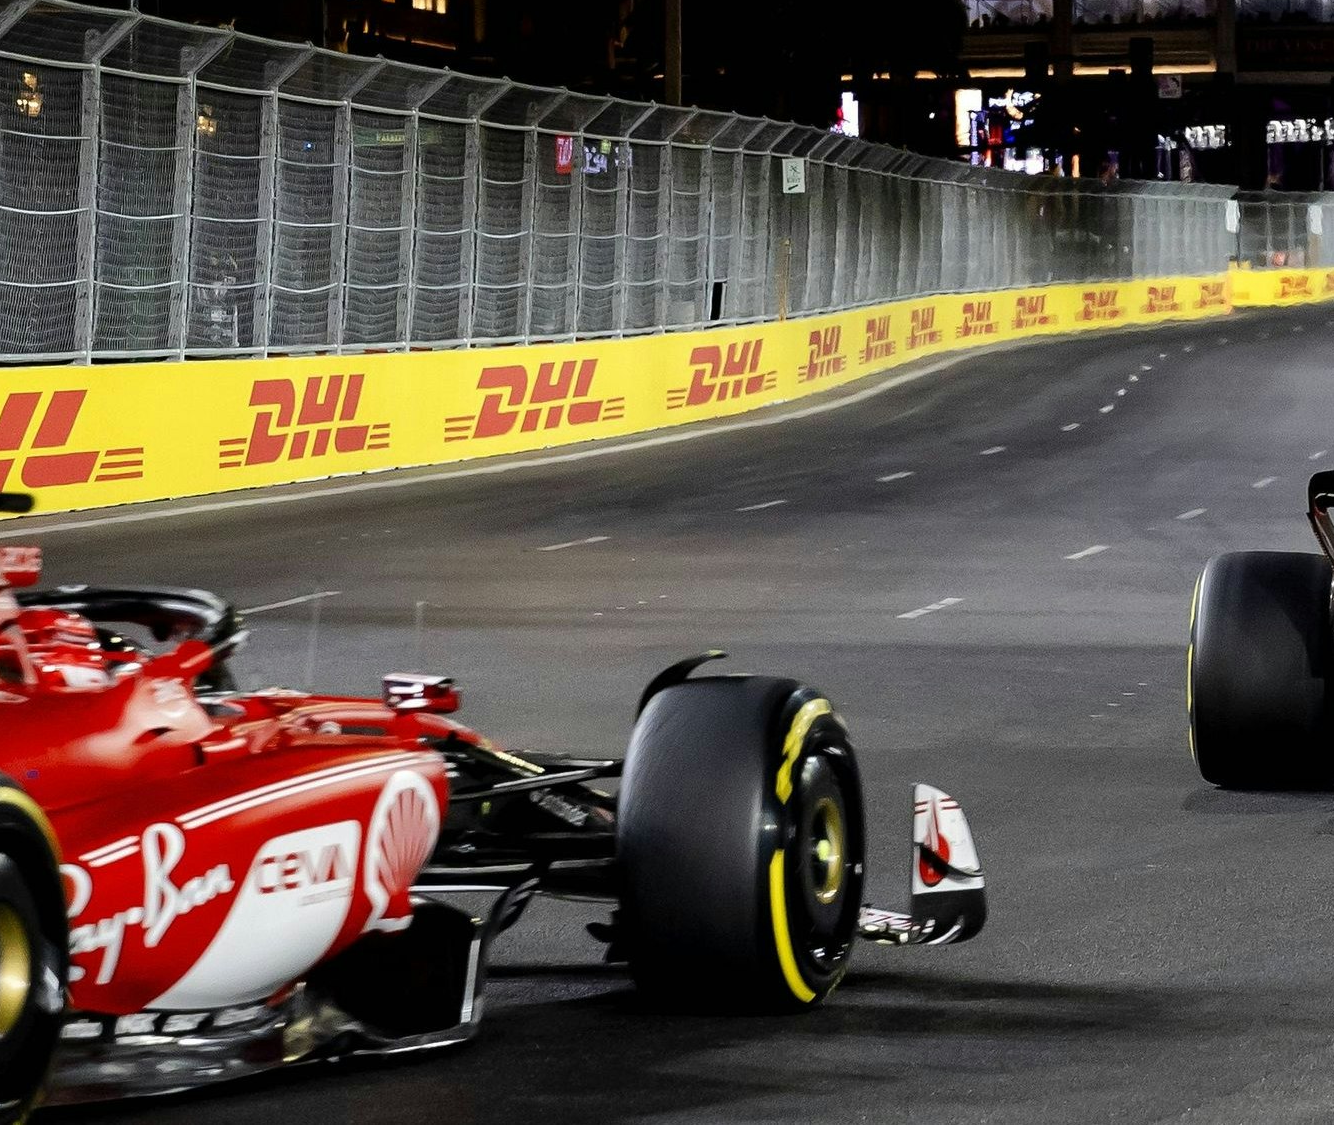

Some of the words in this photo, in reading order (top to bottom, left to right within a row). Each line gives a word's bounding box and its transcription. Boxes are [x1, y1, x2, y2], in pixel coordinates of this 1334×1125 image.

[864, 315, 894, 364] DHL
[909, 306, 938, 350] DHL
[961, 301, 994, 337] DHL
[687, 338, 767, 406] DHL
[805, 325, 844, 381] DHL
[244, 374, 369, 465] DHL
[472, 358, 605, 438] DHL
[259, 842, 353, 896] CEVA
